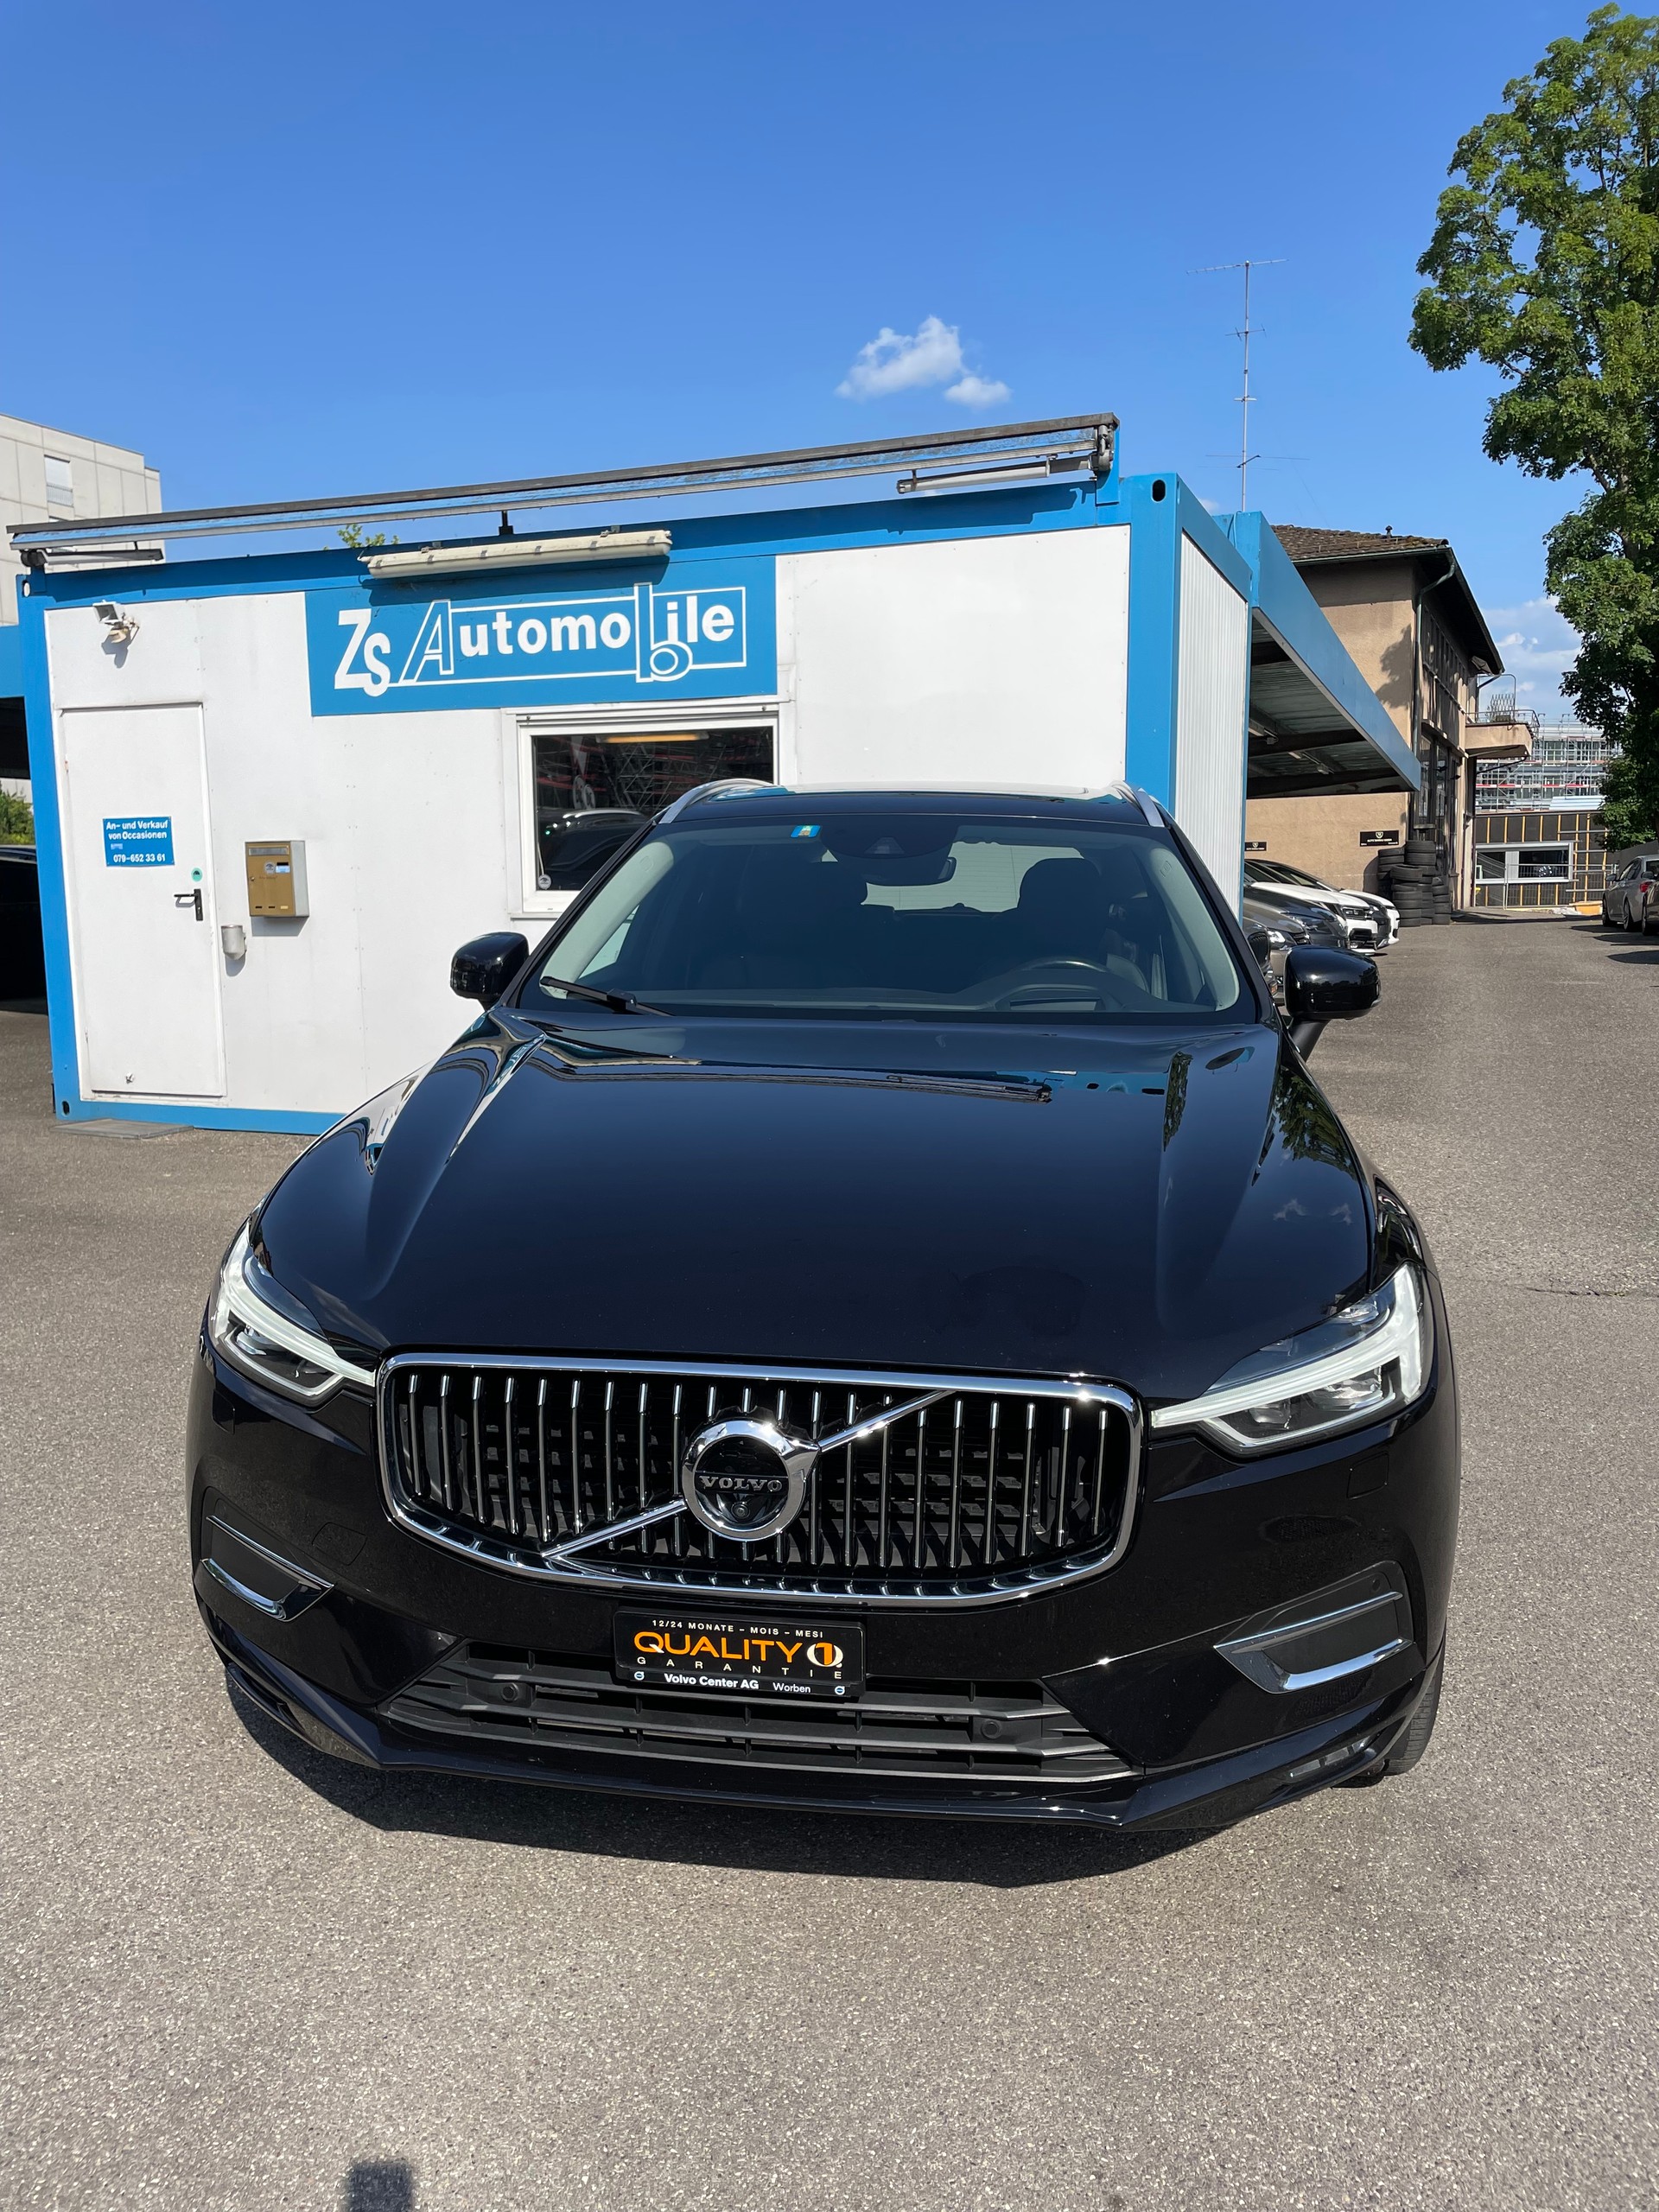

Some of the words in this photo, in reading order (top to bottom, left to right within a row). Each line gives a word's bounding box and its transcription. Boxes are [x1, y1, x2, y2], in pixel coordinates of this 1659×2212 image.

[398, 582, 736, 685] Automobile
[122, 821, 137, 830] und
[137, 820, 168, 830] Verkauf
[122, 830, 167, 840] Occasionen
[113, 854, 144, 862] 079-652
[145, 853, 156, 862] 33
[156, 853, 166, 862] 61
[698, 1476, 782, 1492] VOLVO
[652, 1619, 683, 1629] 12/24
[688, 1622, 735, 1632] MONATE
[750, 1627, 779, 1636] MOIS
[795, 1630, 823, 1638] MESI
[633, 1631, 804, 1663] QUALITY
[637, 1656, 842, 1679] GARANTIE
[664, 1673, 696, 1685] Volvo
[699, 1675, 739, 1688] Center
[741, 1679, 760, 1689] AG
[772, 1681, 811, 1694] Worben
